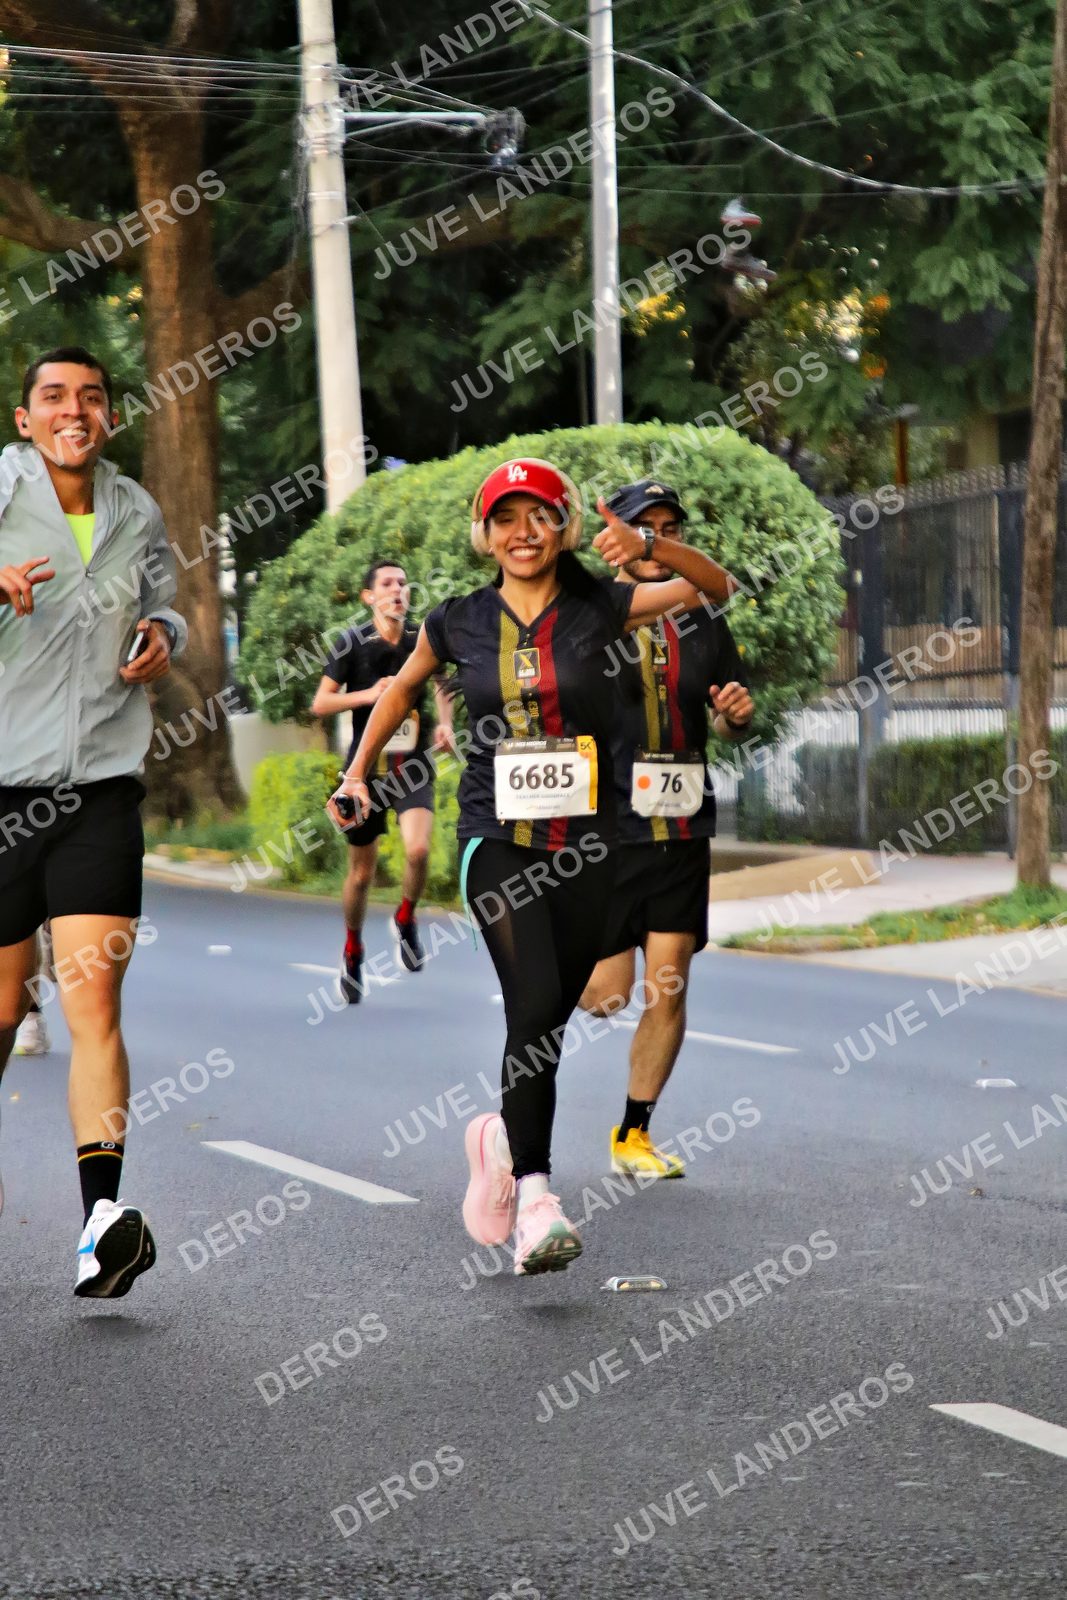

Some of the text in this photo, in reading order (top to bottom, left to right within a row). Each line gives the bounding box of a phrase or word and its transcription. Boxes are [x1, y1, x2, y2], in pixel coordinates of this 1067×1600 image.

[508, 464, 527, 482] LA
[509, 763, 575, 790] 6685
[661, 772, 682, 793] 76
